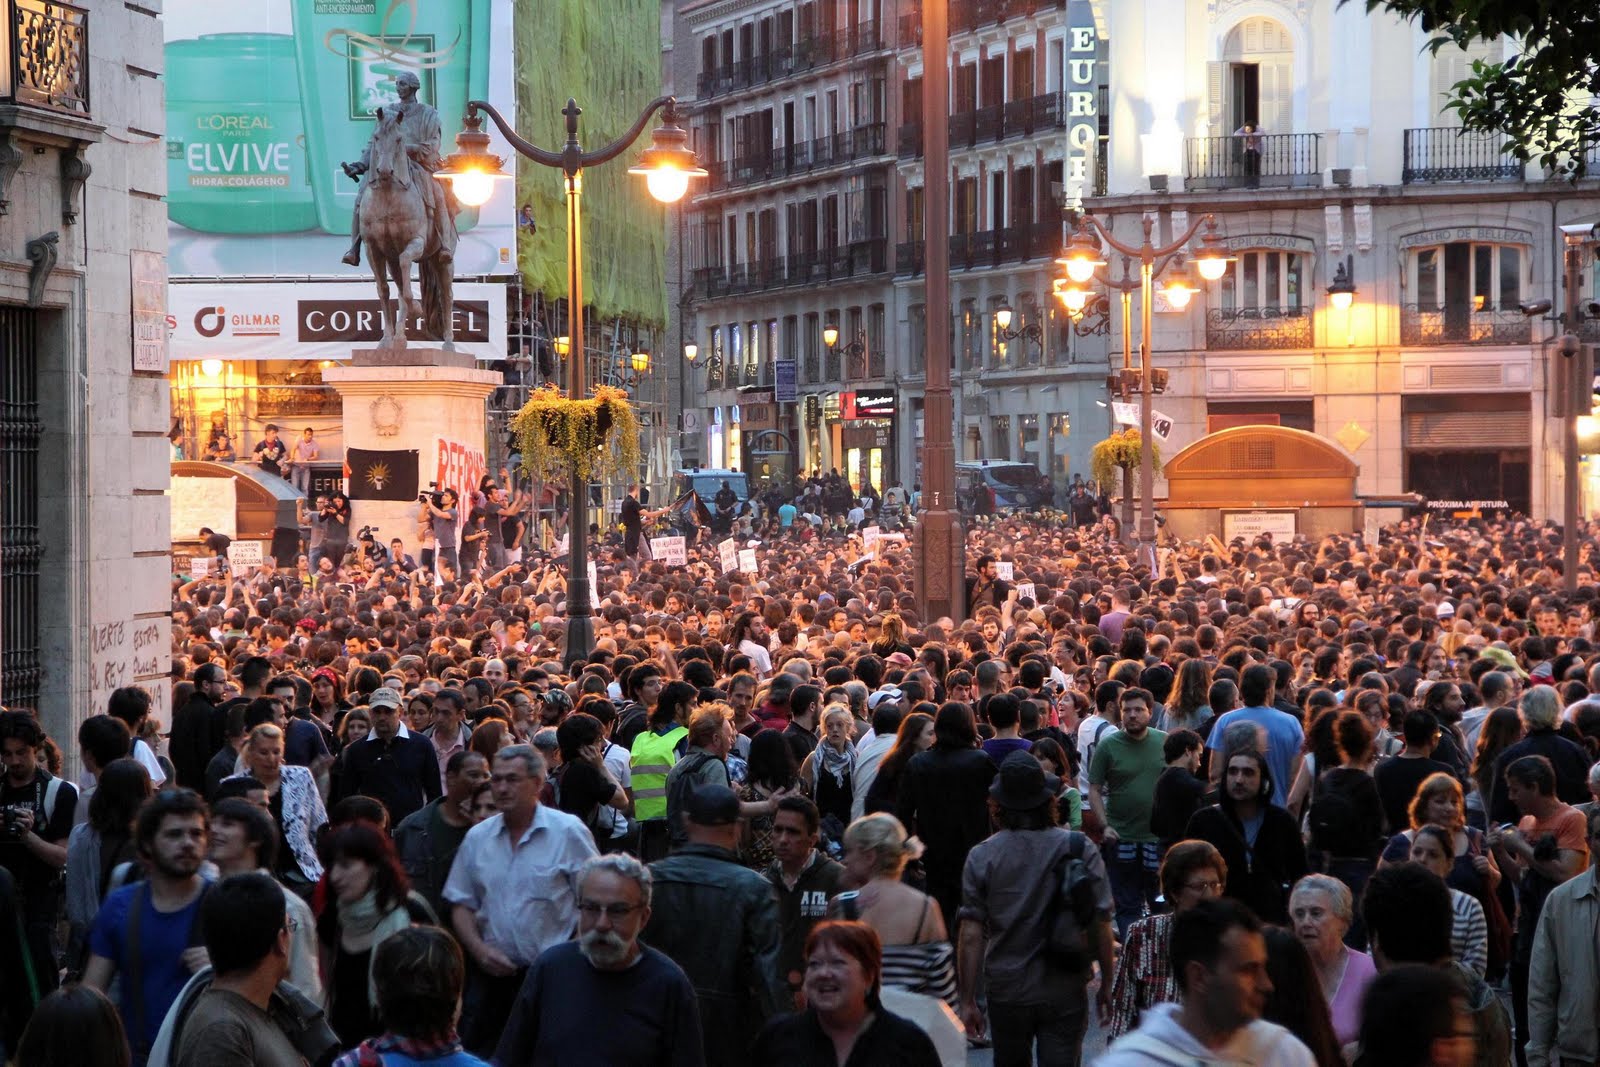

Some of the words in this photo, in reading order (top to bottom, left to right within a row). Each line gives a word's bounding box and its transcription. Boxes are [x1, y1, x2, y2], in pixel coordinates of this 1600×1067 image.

[222, 129, 251, 137] PARIS
[187, 142, 289, 172] ELVIVE
[191, 176, 286, 187] HIDRA-COLÁGENO
[1406, 230, 1451, 246] CENTRO
[1457, 229, 1472, 239] DE
[1477, 228, 1525, 241] BELLEZA
[231, 314, 281, 326] GILMAR
[1427, 499, 1465, 508] PRÓXIMA
[104, 660, 126, 691] REY
